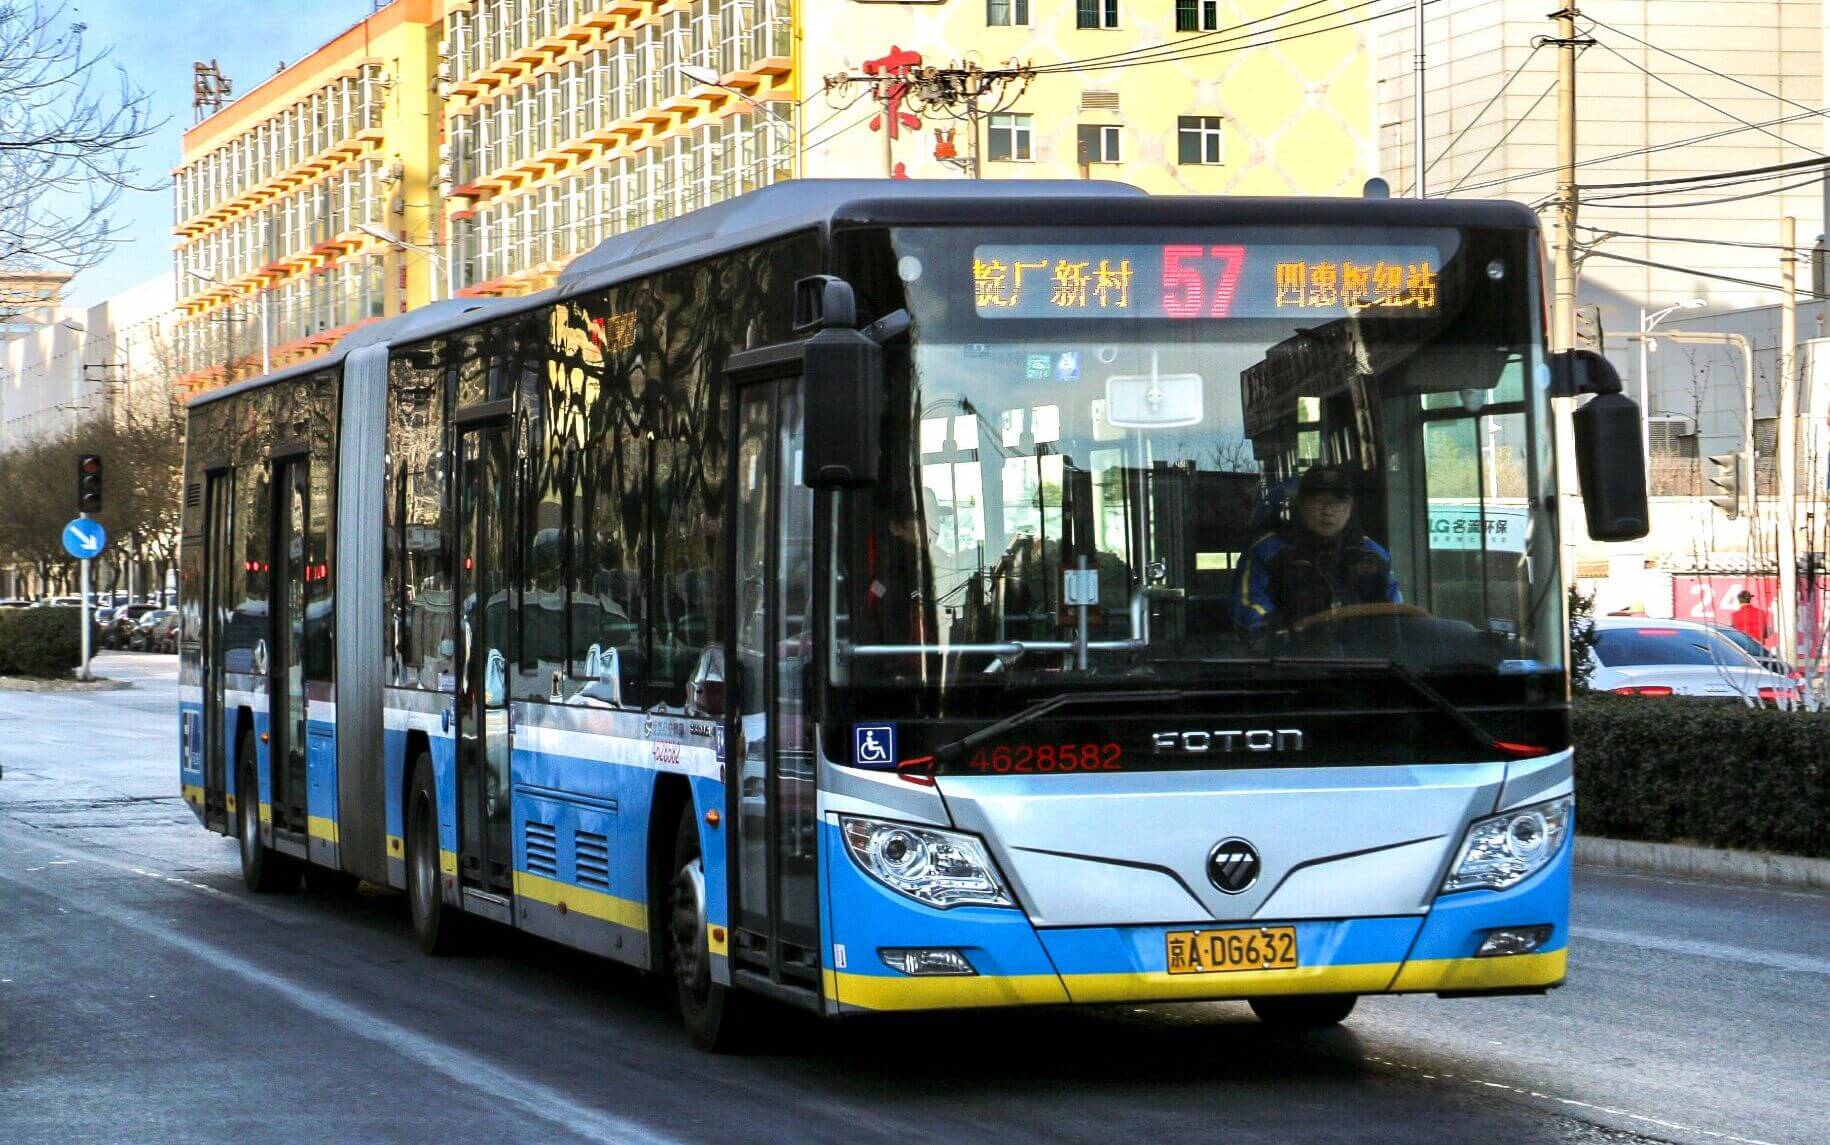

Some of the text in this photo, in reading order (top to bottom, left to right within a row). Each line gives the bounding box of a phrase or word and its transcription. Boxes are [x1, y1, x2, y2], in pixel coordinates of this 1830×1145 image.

[1163, 245, 1245, 317] 57
[1152, 729, 1303, 753] FOTON
[969, 743, 1123, 773] 4628582
